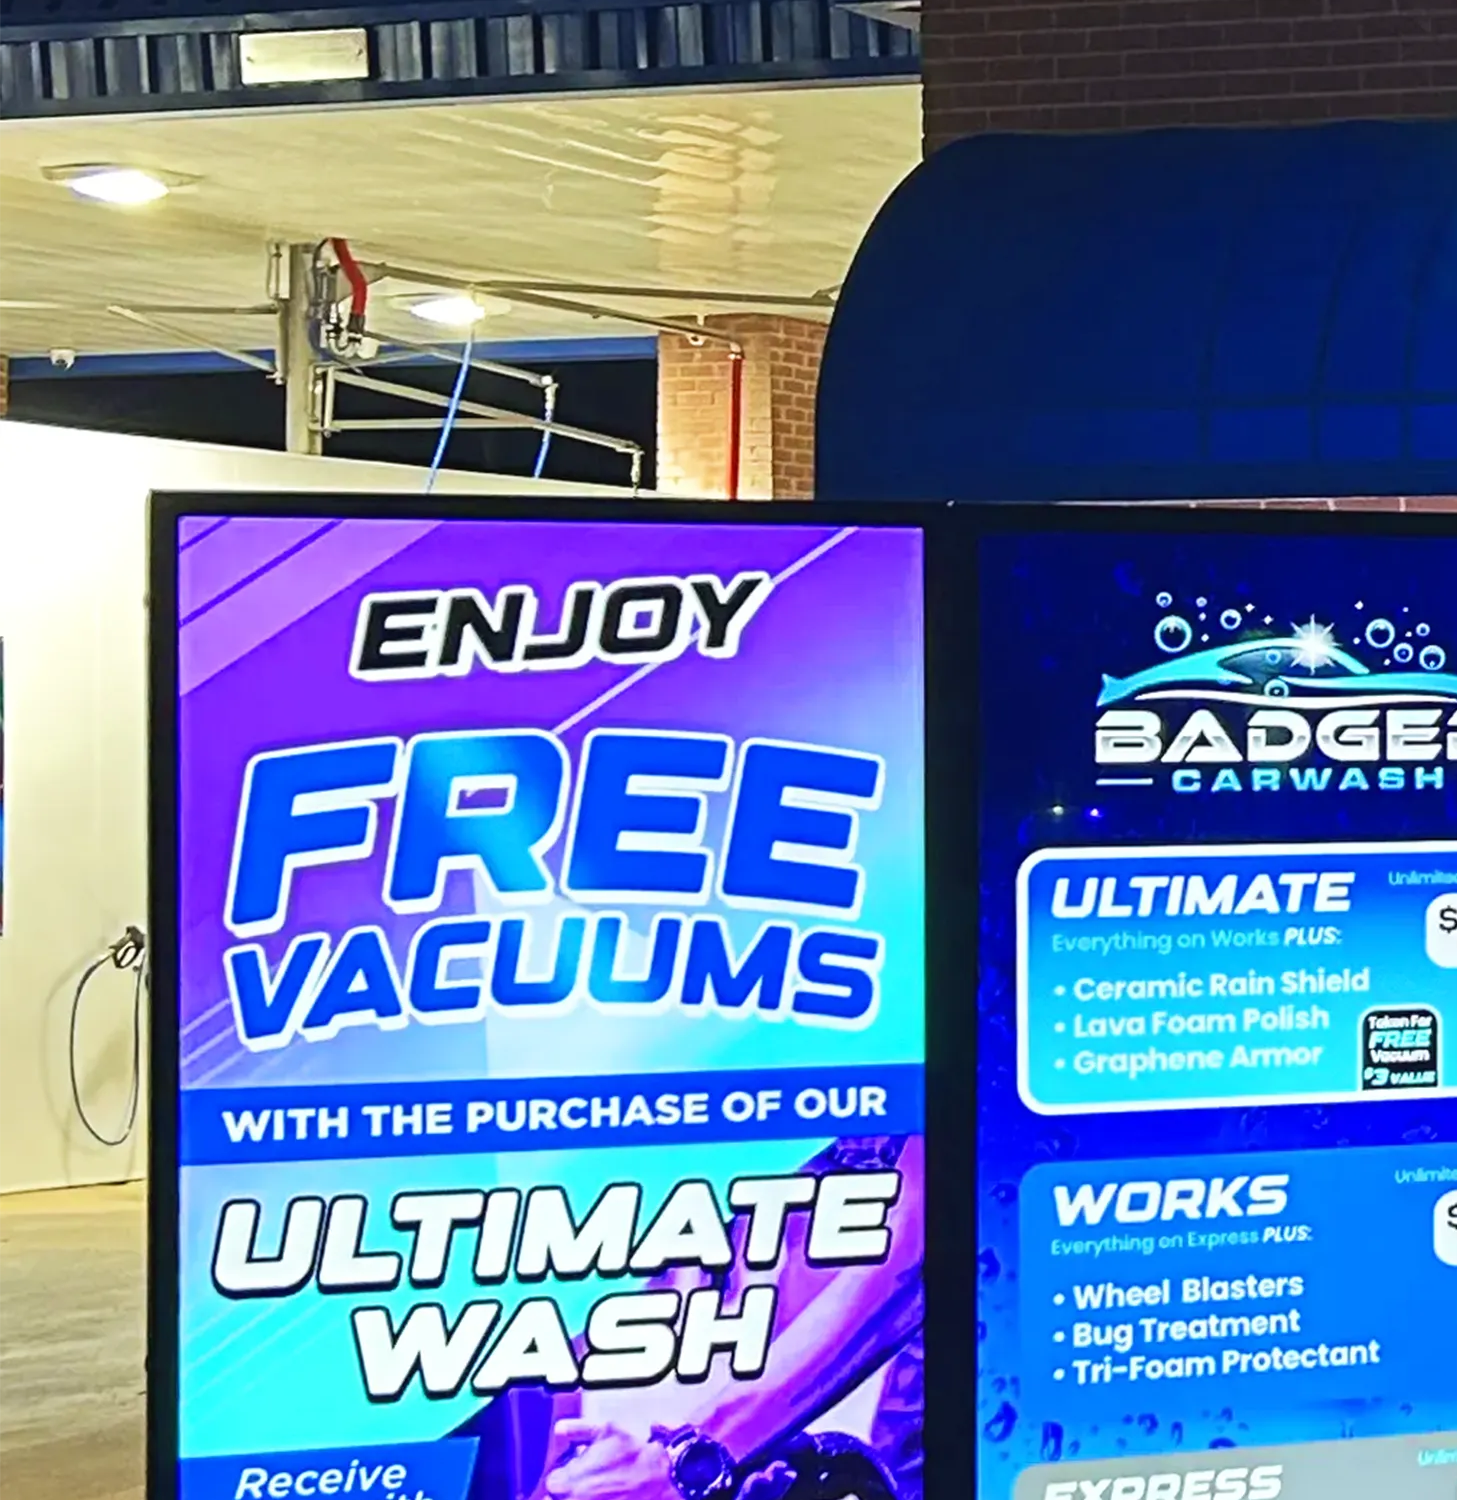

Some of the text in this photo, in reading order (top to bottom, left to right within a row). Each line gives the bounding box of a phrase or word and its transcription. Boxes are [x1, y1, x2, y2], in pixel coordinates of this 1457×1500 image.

[353, 576, 767, 677] ENJOY
[1171, 766, 1445, 792] CARWASH
[225, 729, 884, 935] FREE
[1051, 871, 1356, 919] ULTIMATE
[1052, 926, 1342, 955] Everything on Works PLUS:
[224, 915, 885, 1050] VACUUMS
[1073, 966, 1370, 1002] Ceramic Rain Shield
[1073, 1004, 1330, 1039] Lava Foam Polish
[1368, 1028, 1433, 1049] FREE
[1073, 1044, 1325, 1080] Graphene Armor
[221, 1086, 888, 1143] WITH THE PURCHASE OF OUR
[1052, 1174, 1290, 1227] WORKS
[211, 1170, 902, 1298] ULTIMATE
[1051, 1225, 1313, 1258] Everything on Express PLUS:
[1073, 1274, 1305, 1310] Wheel Blasters
[351, 1284, 777, 1403] WASH
[1072, 1308, 1302, 1353] Bug Treatment
[1072, 1339, 1381, 1386] Tri-Foam Protectant
[234, 1459, 407, 1500] Receive
